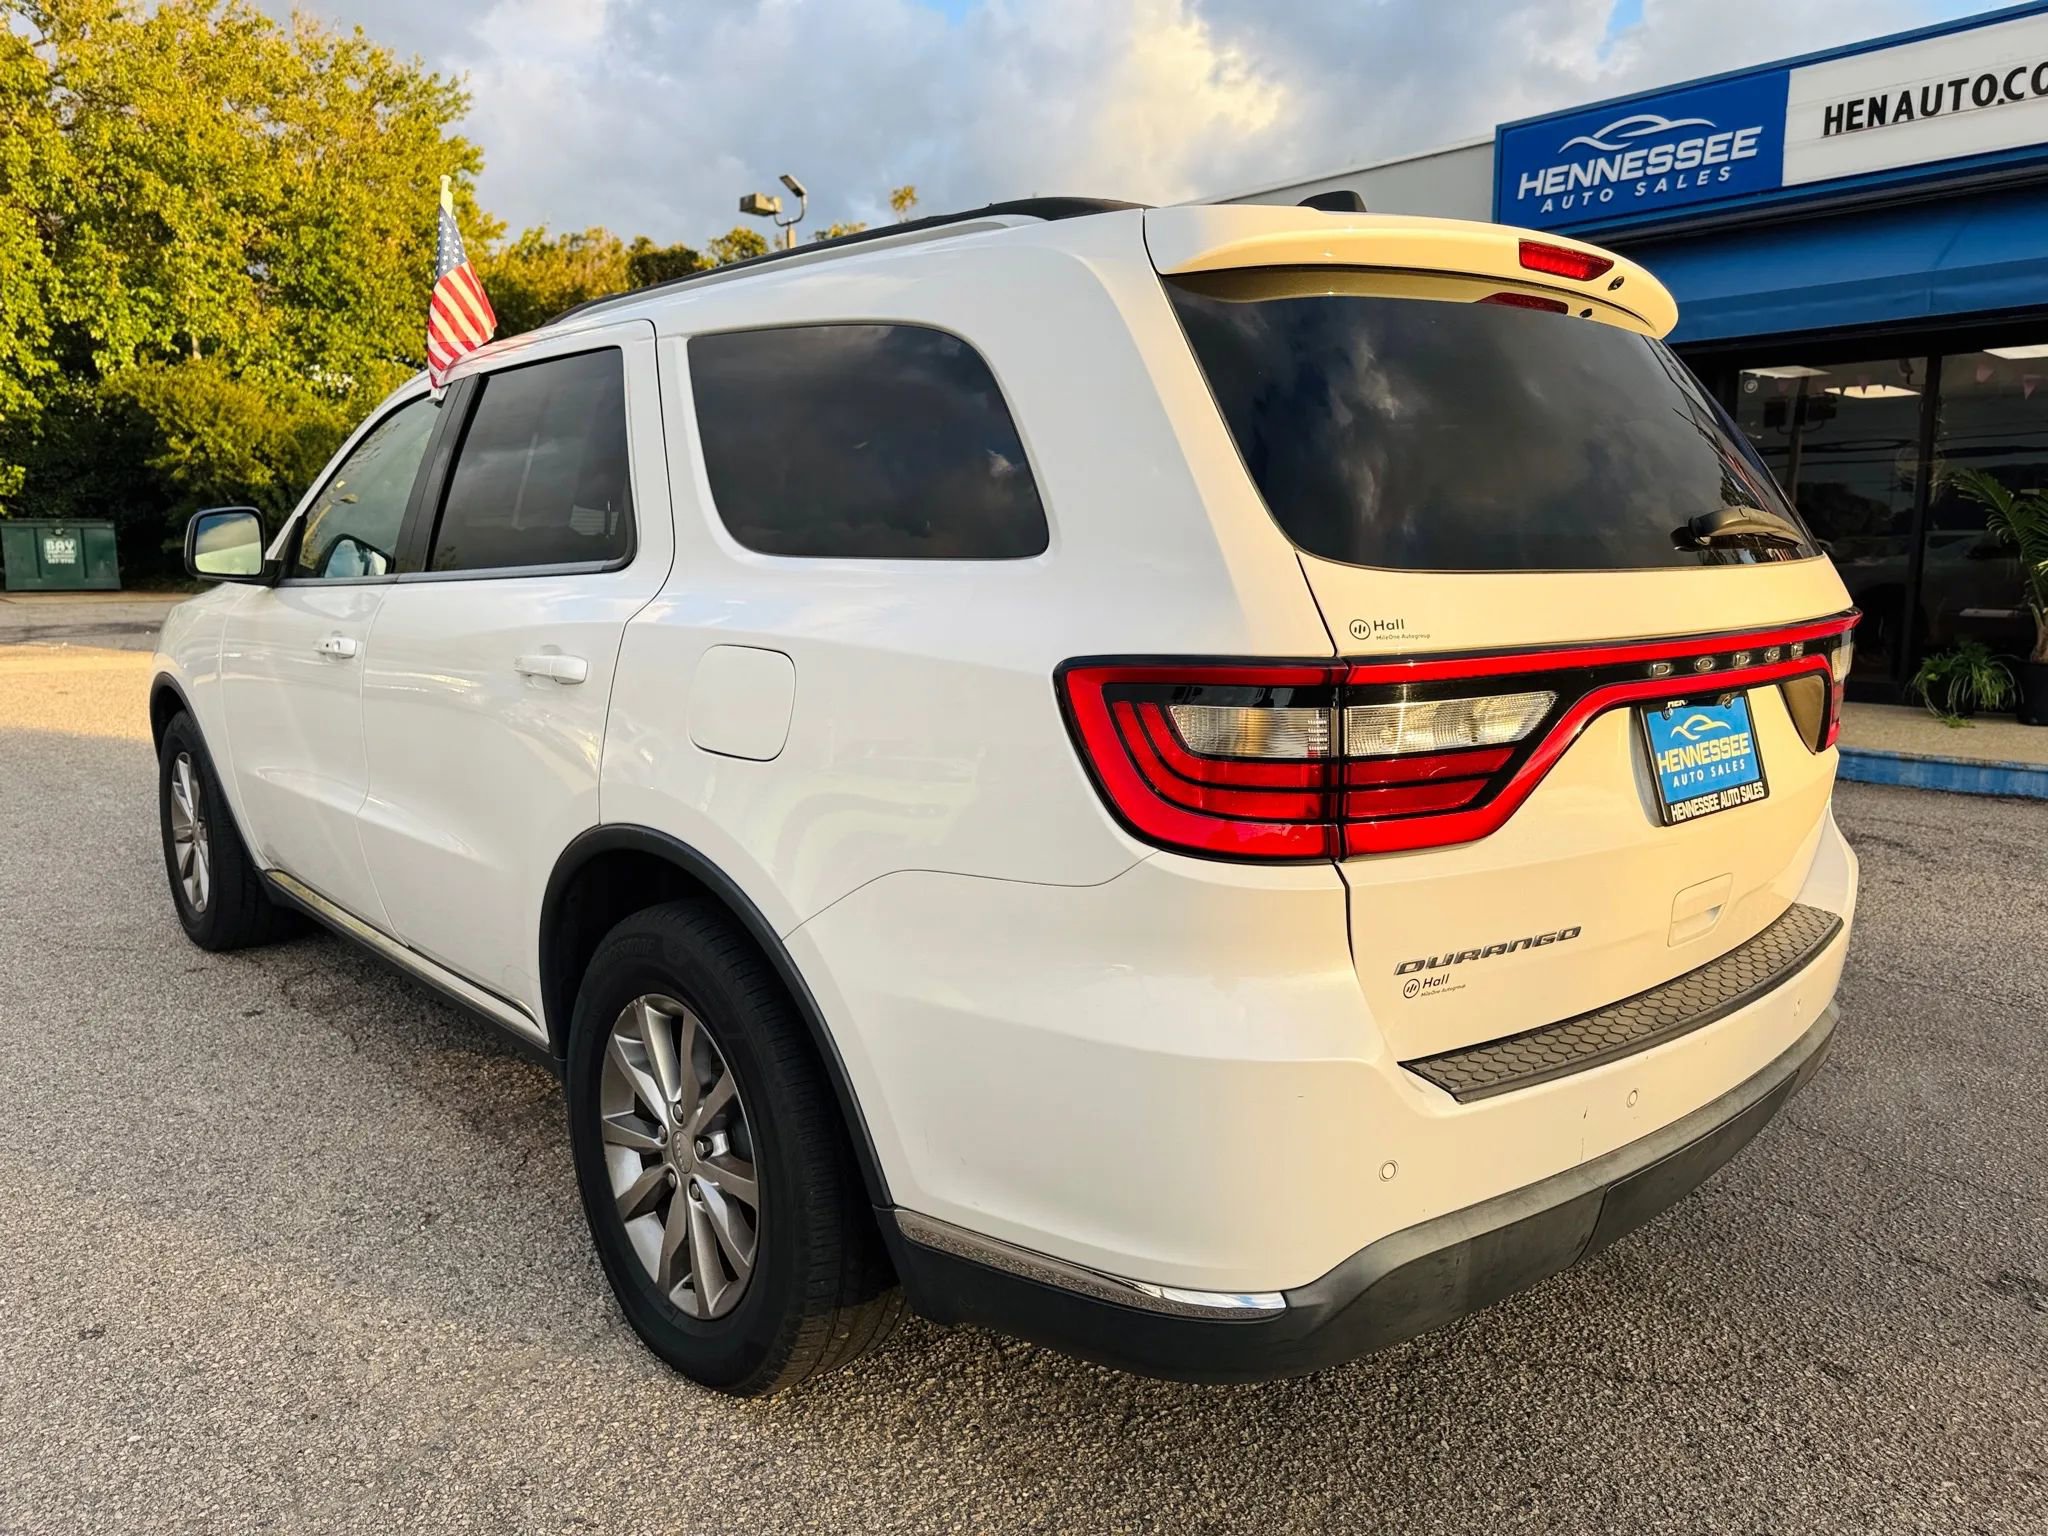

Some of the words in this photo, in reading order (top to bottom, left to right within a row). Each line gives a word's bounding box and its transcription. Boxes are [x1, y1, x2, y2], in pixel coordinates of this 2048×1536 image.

[1517, 126, 1763, 200] HENNESSEE
[1540, 187, 1614, 213] AUTO
[1634, 165, 1733, 197] SALES
[46, 540, 74, 553] BAY
[1373, 618, 1405, 631] Hall
[1651, 642, 1804, 677] DODGE
[1657, 732, 1751, 775] HENNESSEE
[1673, 770, 1704, 788] AUTO
[1711, 758, 1746, 777] SALES
[1670, 793, 1720, 822] HENNESSEE
[1720, 788, 1739, 808] AUTO
[1739, 781, 1764, 802] SALES
[1394, 926, 1582, 976] DURANGO
[1422, 973, 1450, 989] Hall
